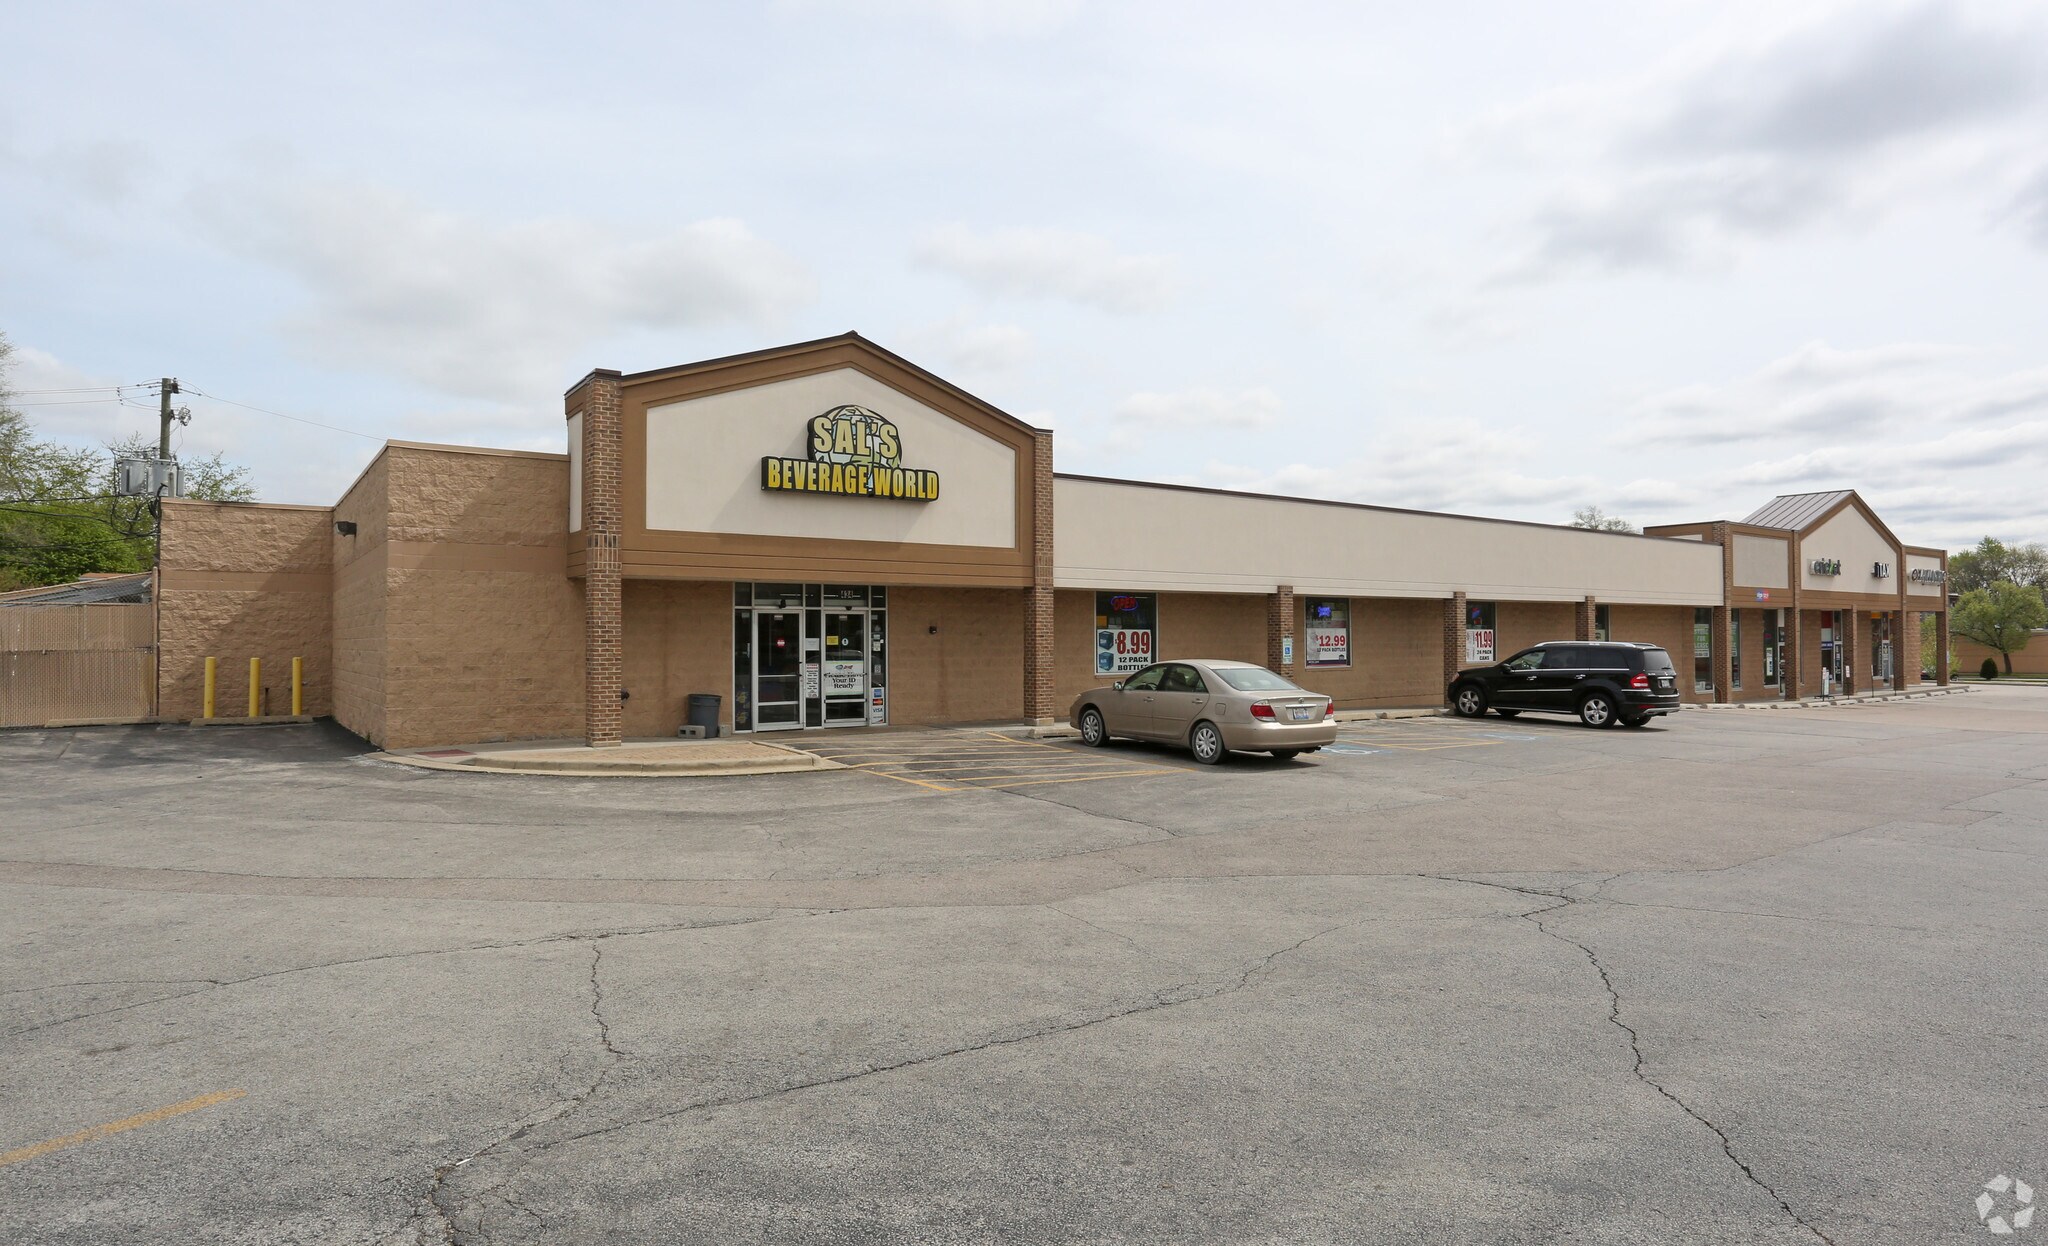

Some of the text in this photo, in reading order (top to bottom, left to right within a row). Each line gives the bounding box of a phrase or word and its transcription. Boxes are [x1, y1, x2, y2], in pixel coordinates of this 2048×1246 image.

[813, 417, 898, 459] SAL'S
[767, 458, 938, 499] BEVERAGE WORLD
